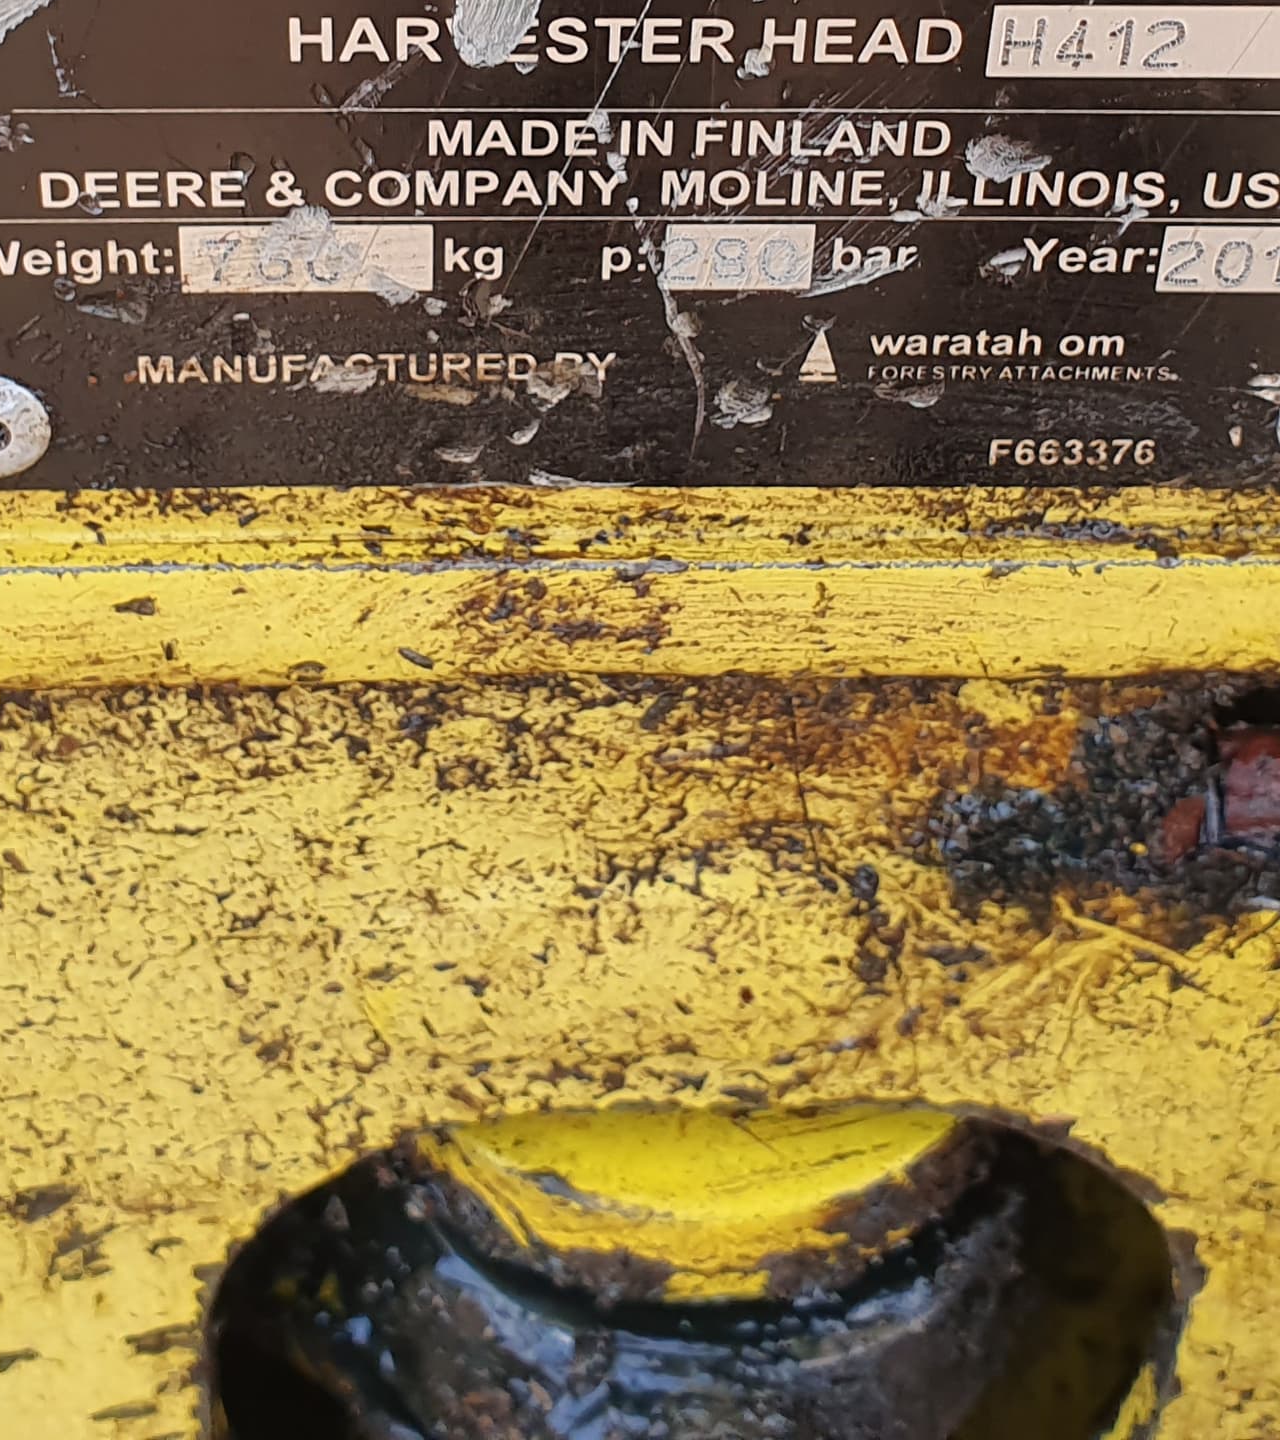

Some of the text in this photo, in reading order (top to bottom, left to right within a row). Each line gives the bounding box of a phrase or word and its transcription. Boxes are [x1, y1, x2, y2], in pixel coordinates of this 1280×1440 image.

[288, 16, 964, 65] HARSTER HEAD
[999, 18, 1188, 69] H412
[426, 118, 952, 158] MADE IN FINLAND
[40, 169, 245, 209] DEERE
[265, 170, 307, 207] &
[324, 169, 639, 213] COMPANY,
[661, 169, 898, 213] MOLINE,
[921, 169, 1180, 213] ILLINOIS,
[444, 238, 505, 279] kg
[601, 236, 919, 283] p: 280 bar
[1024, 237, 1158, 274] Year:
[870, 329, 1125, 357] waratah om
[137, 351, 537, 384] MANUFACTURED
[868, 364, 992, 382] FORESTRY
[988, 438, 1156, 466] F663376
